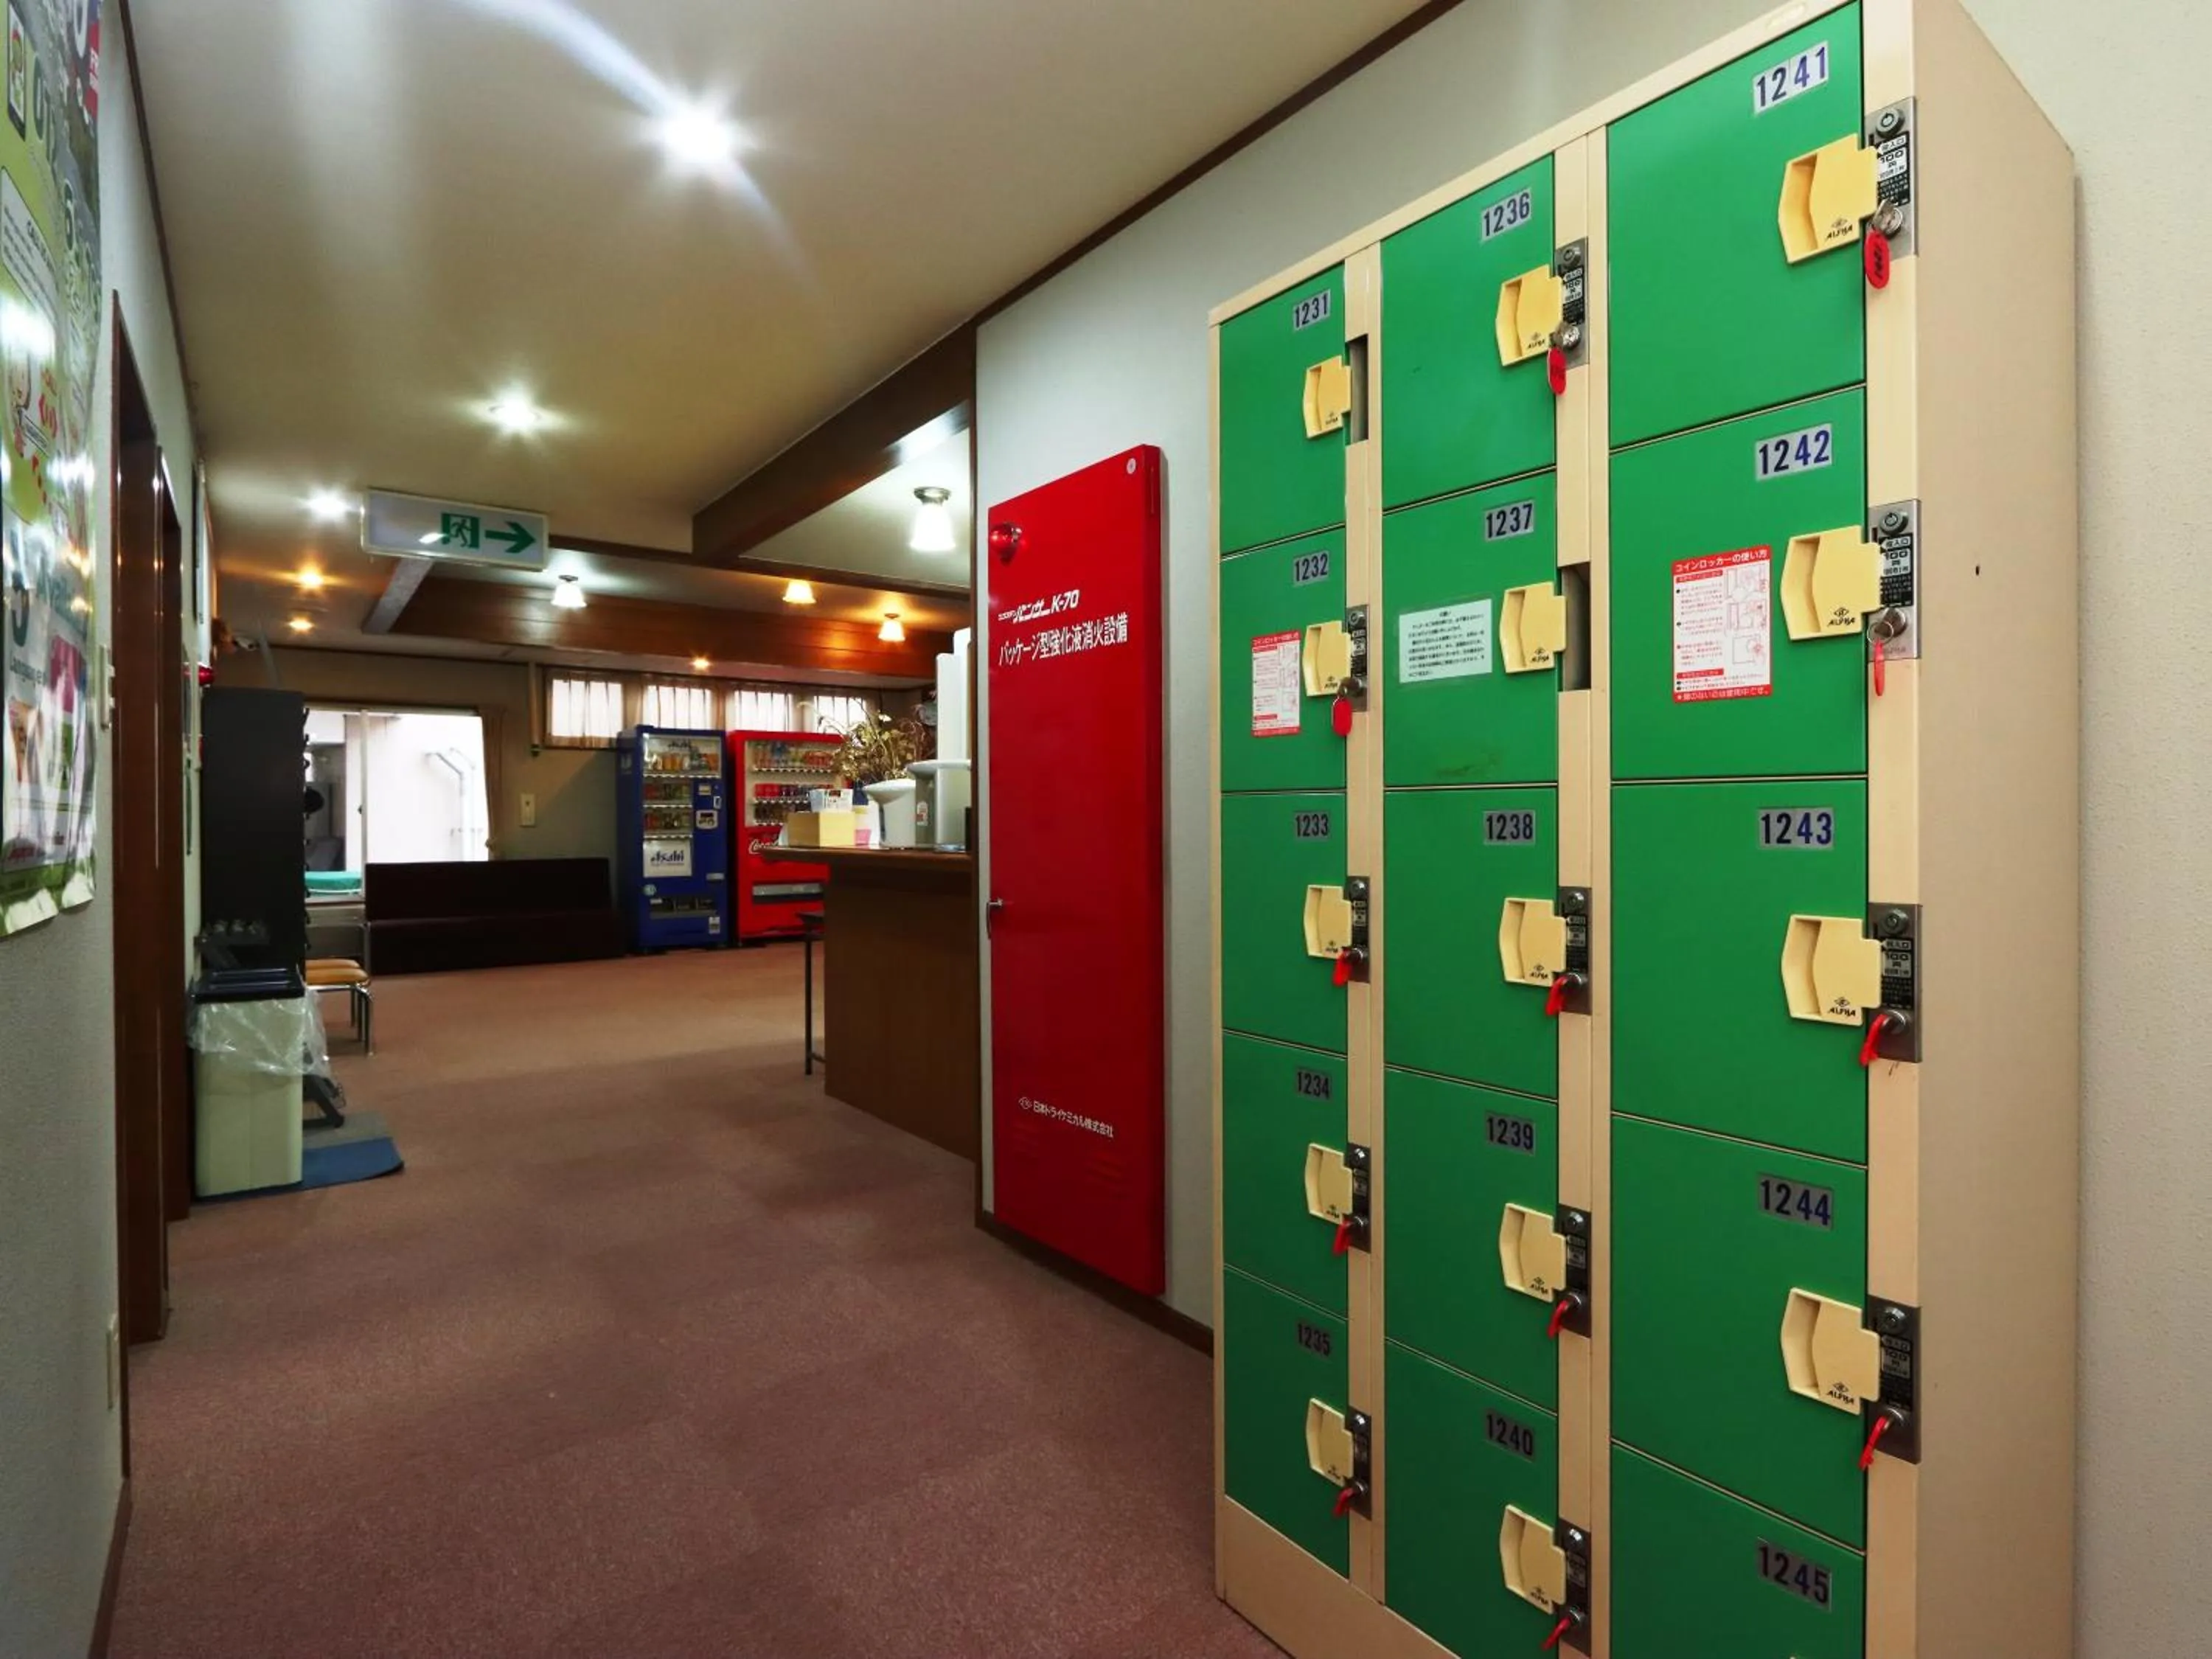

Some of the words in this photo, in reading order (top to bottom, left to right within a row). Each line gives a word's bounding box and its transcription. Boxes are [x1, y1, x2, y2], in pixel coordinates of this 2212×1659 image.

[1756, 46, 1826, 108] 1241
[1881, 150, 1904, 164] 100
[1484, 192, 1530, 237] 1236
[1825, 225, 1854, 241] ALPHA
[1295, 294, 1328, 327] 1231
[1759, 430, 1829, 476] 1242
[1486, 503, 1533, 539] 1237
[1295, 554, 1329, 582] 1232
[1676, 549, 1768, 572] コインロッカーの使い方
[1885, 550, 1908, 560] 100
[1051, 589, 1080, 614] K-70
[1827, 616, 1856, 627] ALPHA
[998, 611, 1129, 667] パッケージ型強化液消火設備
[1295, 813, 1329, 838] 1233
[1486, 813, 1534, 841] 1238
[1761, 812, 1832, 845] 1243
[650, 849, 684, 862] Asahi
[1827, 1006, 1857, 1018] ALPHA
[1297, 1071, 1330, 1099] 1234
[1486, 1116, 1534, 1151] 1239
[1760, 1179, 1831, 1227] 1244
[1298, 1323, 1331, 1357] 1235
[1826, 1389, 1855, 1406] ALPHA
[1486, 1413, 1534, 1456] 1240
[1758, 1545, 1829, 1604] 1245
